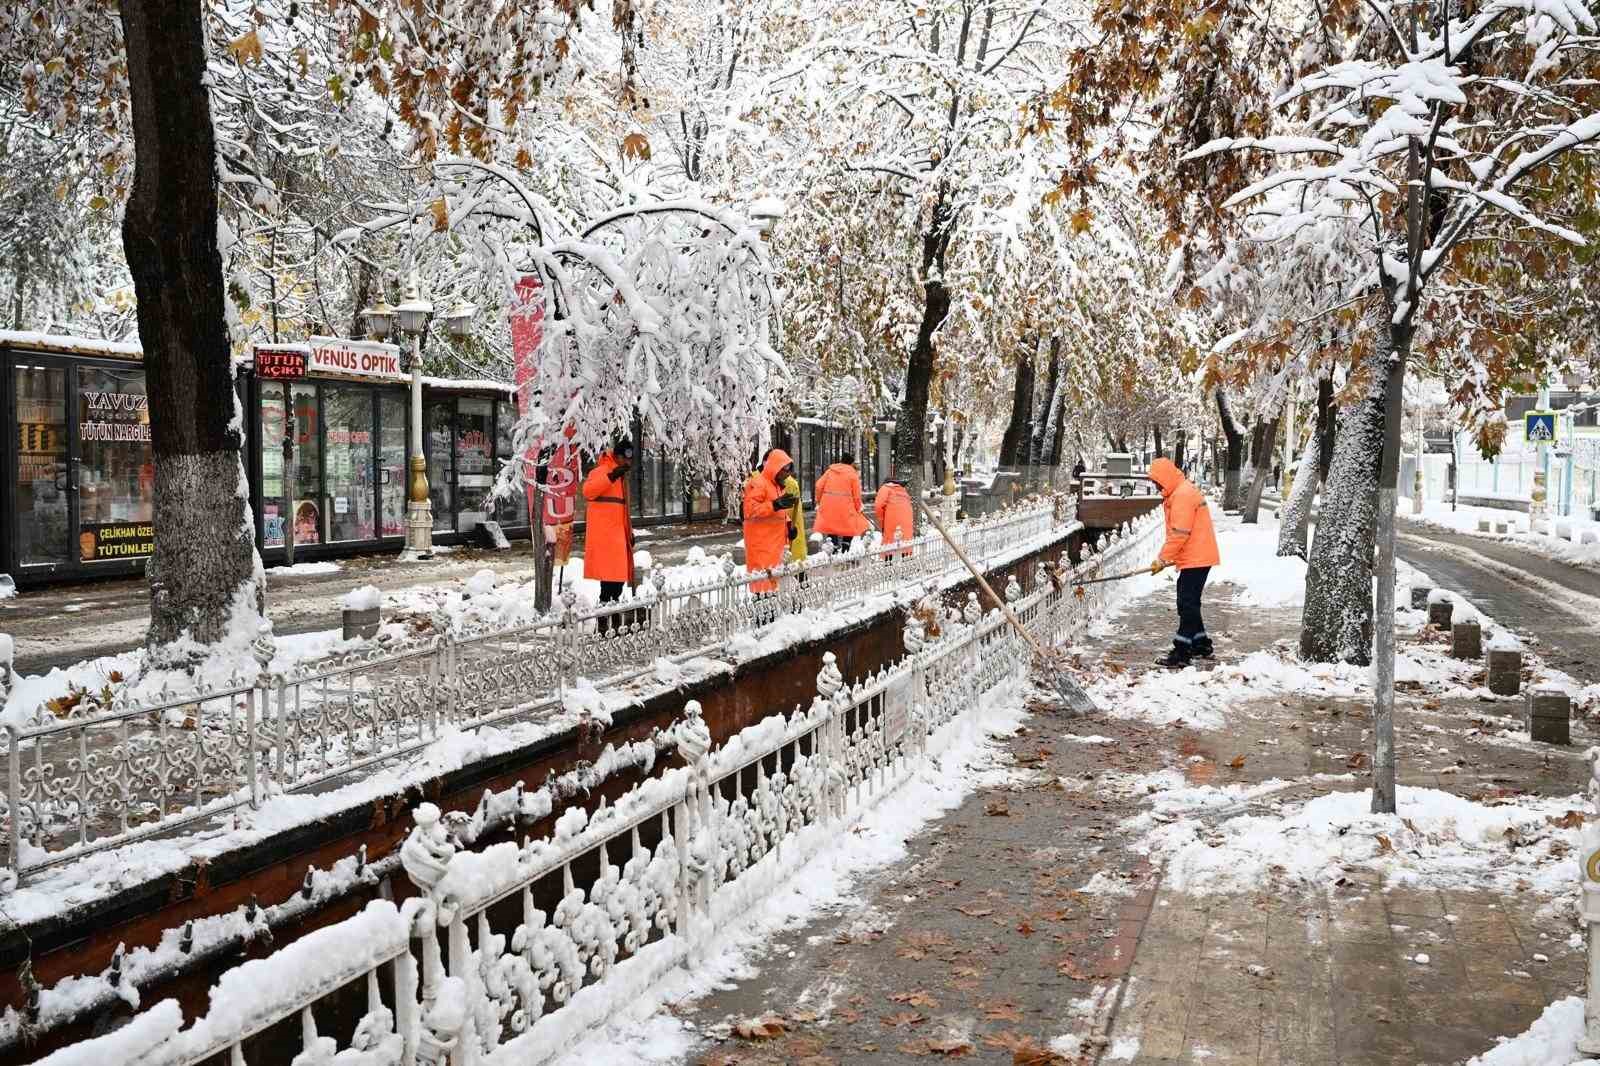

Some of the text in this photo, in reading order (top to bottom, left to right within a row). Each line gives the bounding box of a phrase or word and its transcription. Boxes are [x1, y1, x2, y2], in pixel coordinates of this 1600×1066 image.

[313, 345, 396, 373] VENÜS OPTİK
[84, 391, 148, 411] YAVUZ
[80, 420, 113, 441] TÜTÜN
[100, 525, 154, 542] ÇELİKHAN ÖZEL
